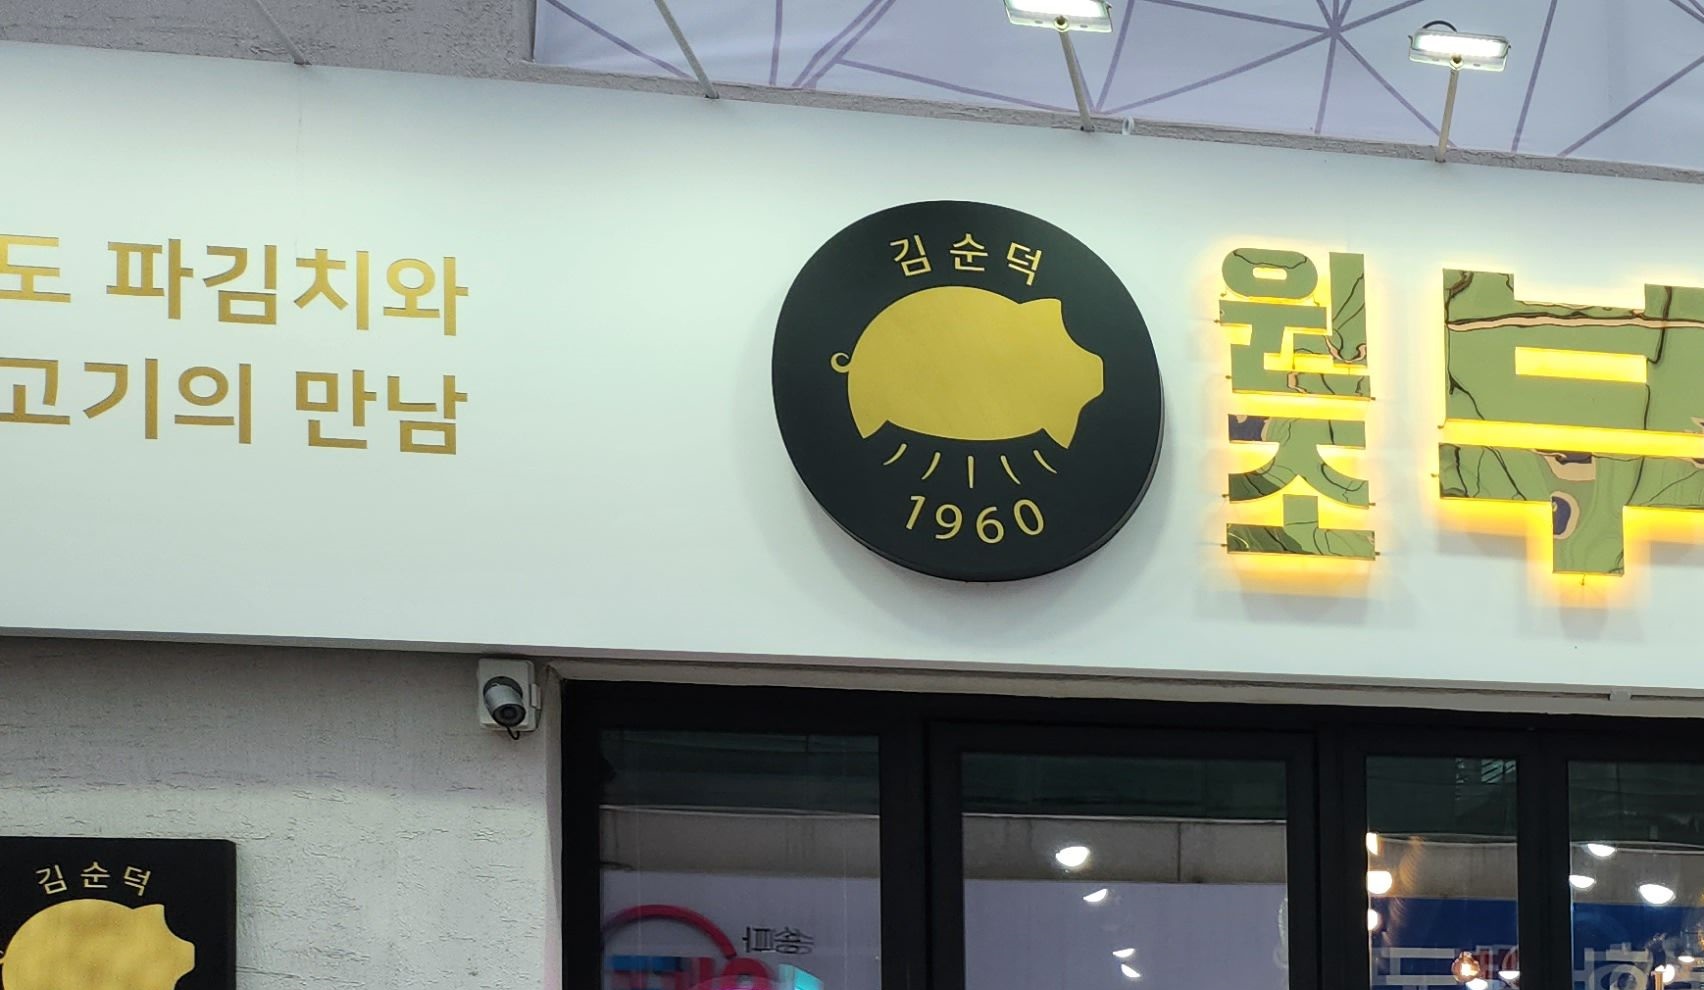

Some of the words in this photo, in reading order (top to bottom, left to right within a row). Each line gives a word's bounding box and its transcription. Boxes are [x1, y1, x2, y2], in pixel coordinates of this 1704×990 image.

[0, 235, 71, 302] 도
[106, 239, 469, 336] 파김치와
[890, 233, 1043, 286] 김순덕
[0, 357, 252, 444] 고기의
[296, 369, 468, 455] 만남
[1218, 247, 1376, 560] 원조
[903, 495, 1045, 544] 1960
[36, 861, 151, 896] 김순덕
